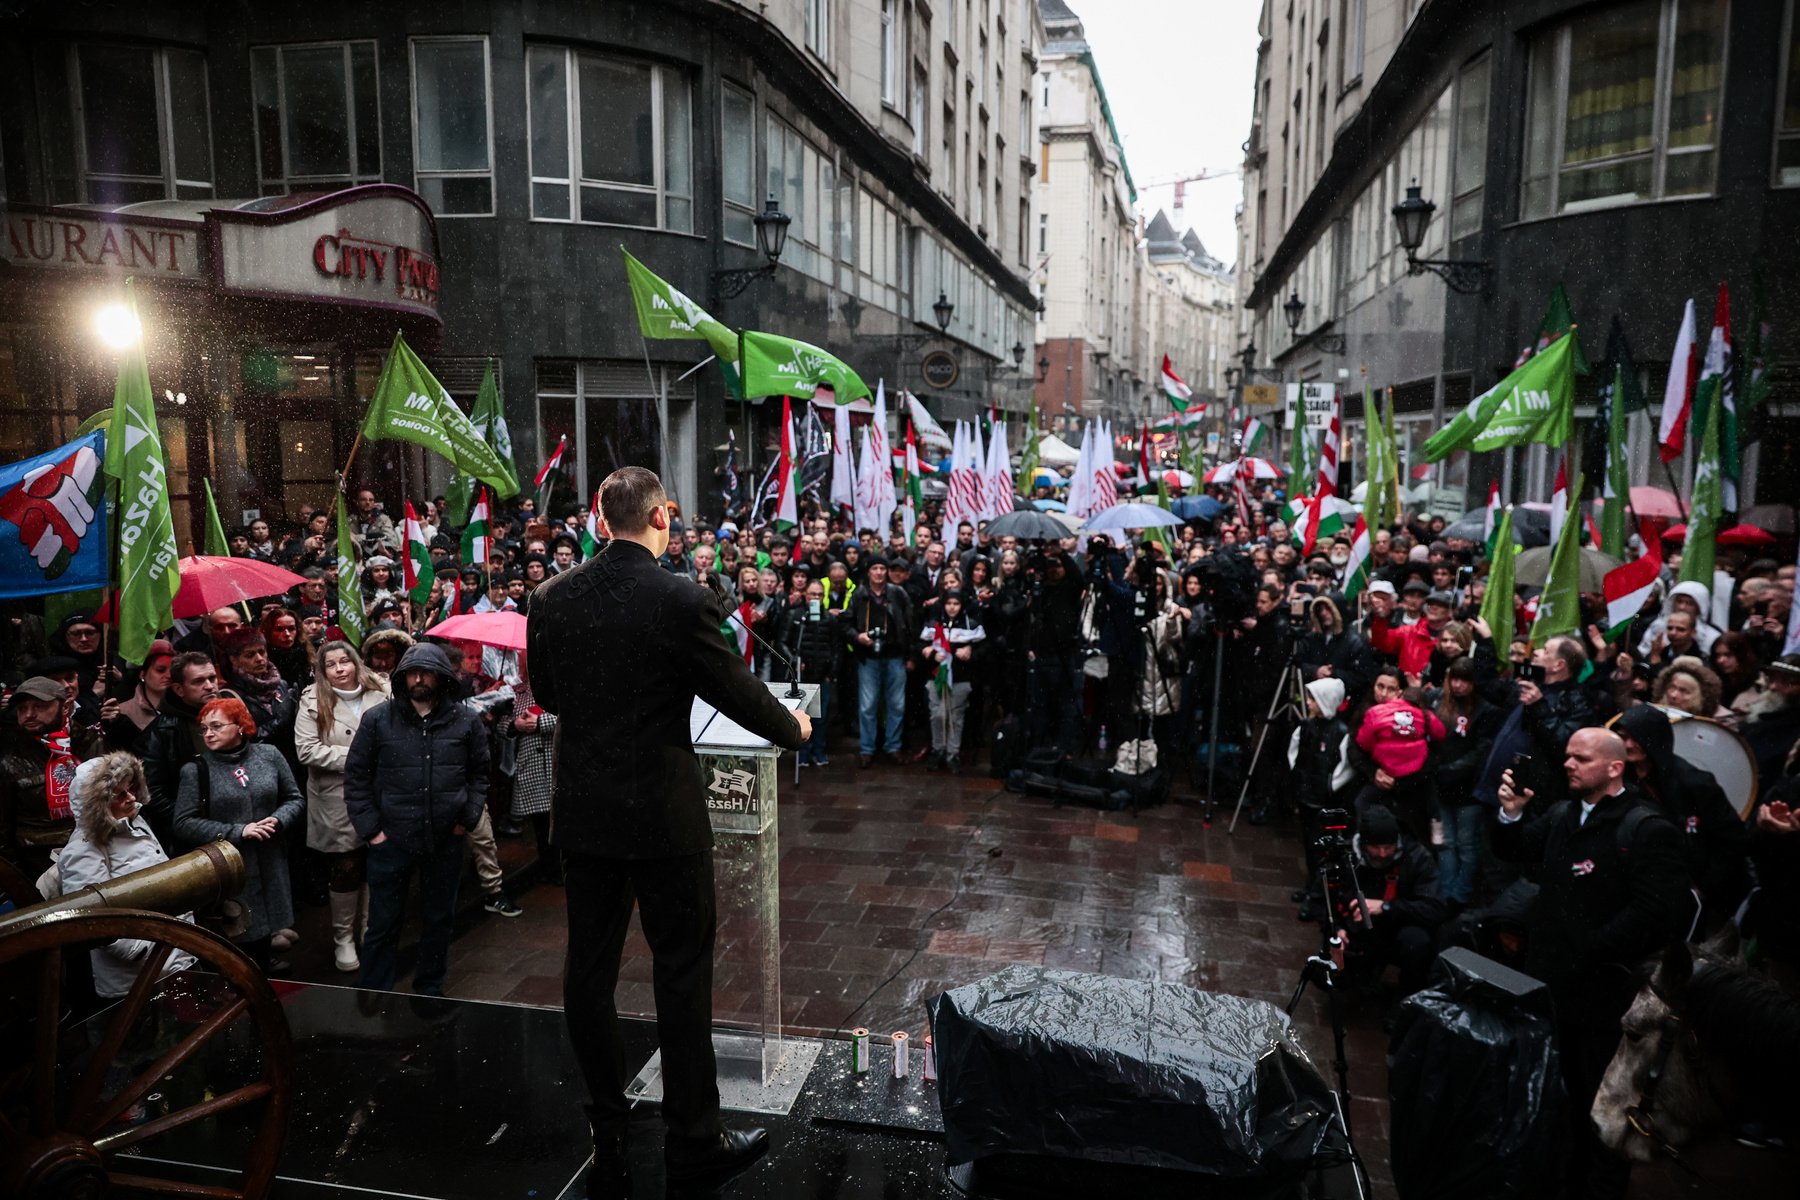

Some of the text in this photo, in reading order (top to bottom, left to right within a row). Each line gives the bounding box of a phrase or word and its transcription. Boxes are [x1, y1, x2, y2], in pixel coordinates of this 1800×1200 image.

[652, 294, 672, 310] M
[778, 360, 799, 374] Mi
[404, 392, 433, 411] Mi
[1289, 401, 1330, 411] MSSAGE
[391, 418, 438, 436] SOMOGY
